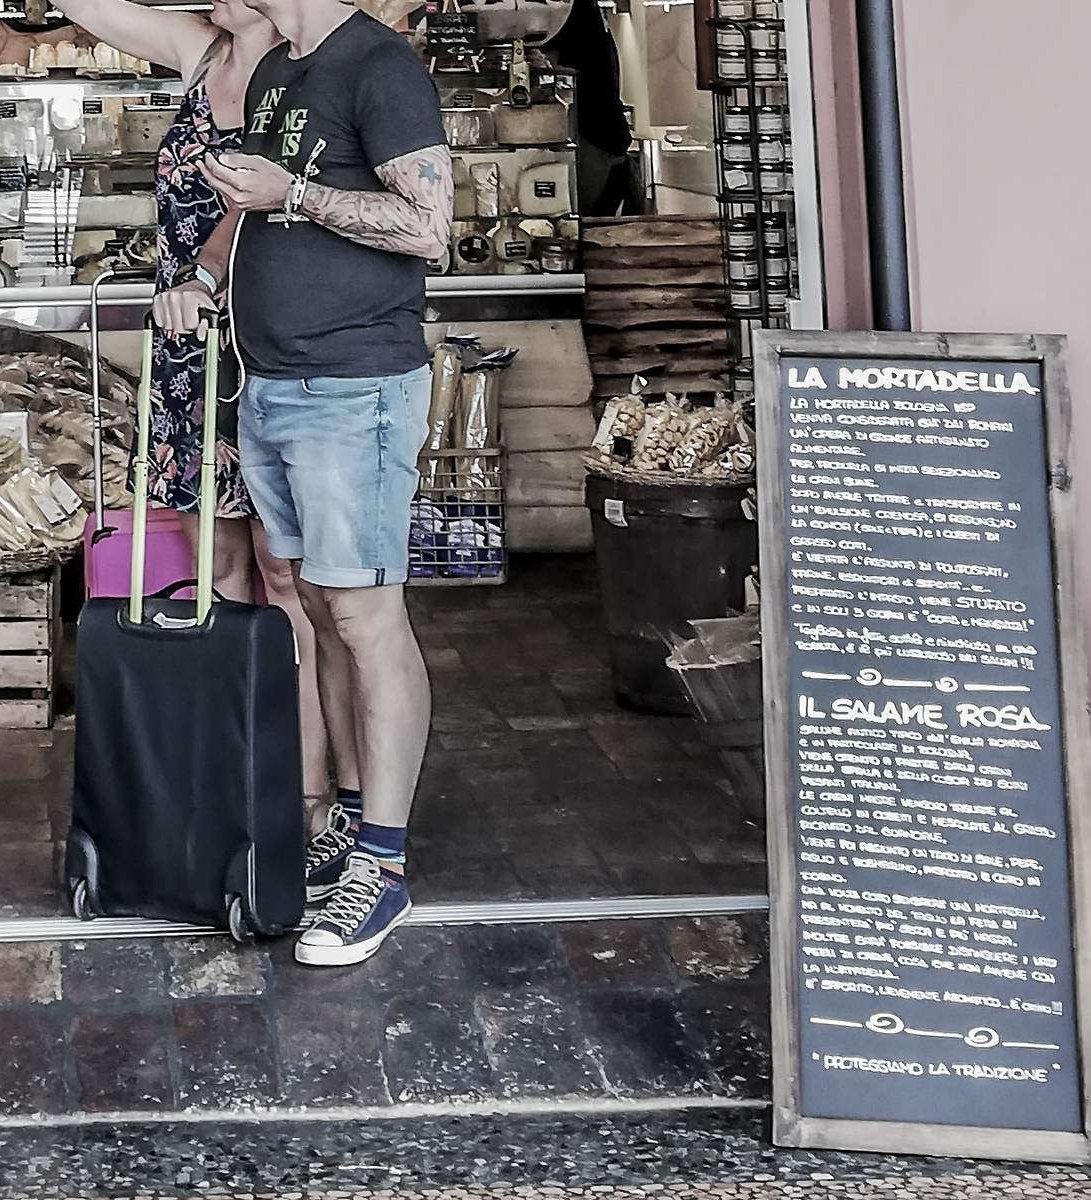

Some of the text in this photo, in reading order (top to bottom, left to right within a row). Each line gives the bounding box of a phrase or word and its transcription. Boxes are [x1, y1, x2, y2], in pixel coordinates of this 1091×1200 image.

[789, 367, 1040, 395] LA MORTADELLA
[790, 398, 808, 408] LA
[955, 597, 1026, 612] STUFATO
[800, 695, 1051, 730] IL SALAME ROSA
[929, 1063, 950, 1075] LA
